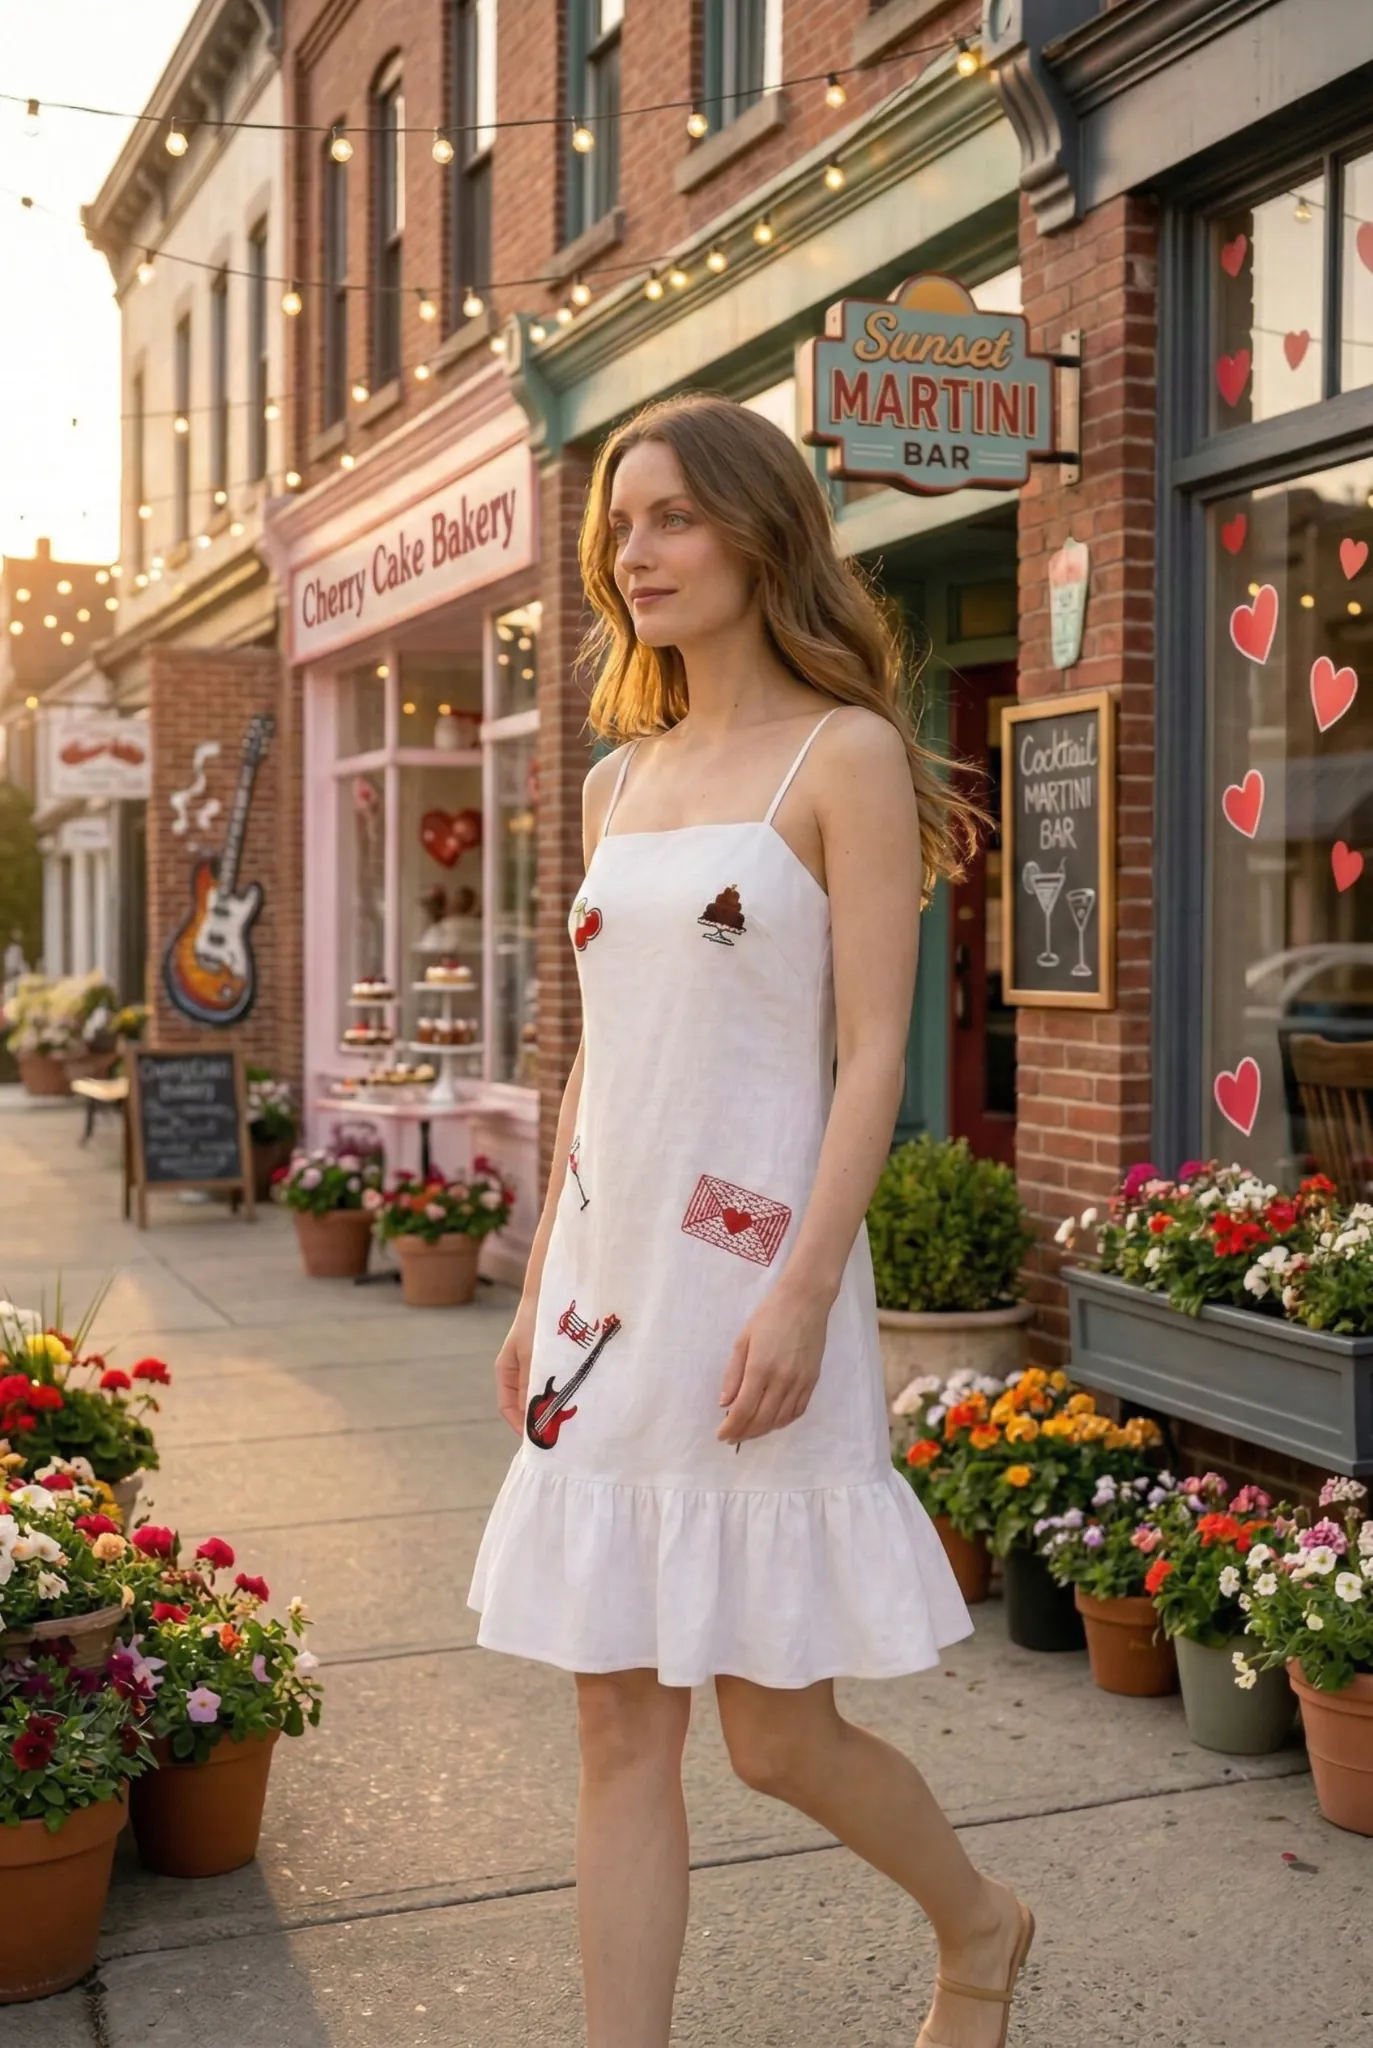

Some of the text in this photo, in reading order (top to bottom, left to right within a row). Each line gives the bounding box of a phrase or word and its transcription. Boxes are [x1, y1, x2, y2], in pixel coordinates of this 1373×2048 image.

[854, 310, 1013, 370] Sunset
[831, 367, 1037, 437] MARTINI
[904, 442, 970, 470] BAR
[303, 489, 516, 628] Cherry Cake Bakery
[1020, 723, 1097, 776] Cocktail
[1024, 776, 1091, 814] MARTINI
[1040, 816, 1077, 850] BAR
